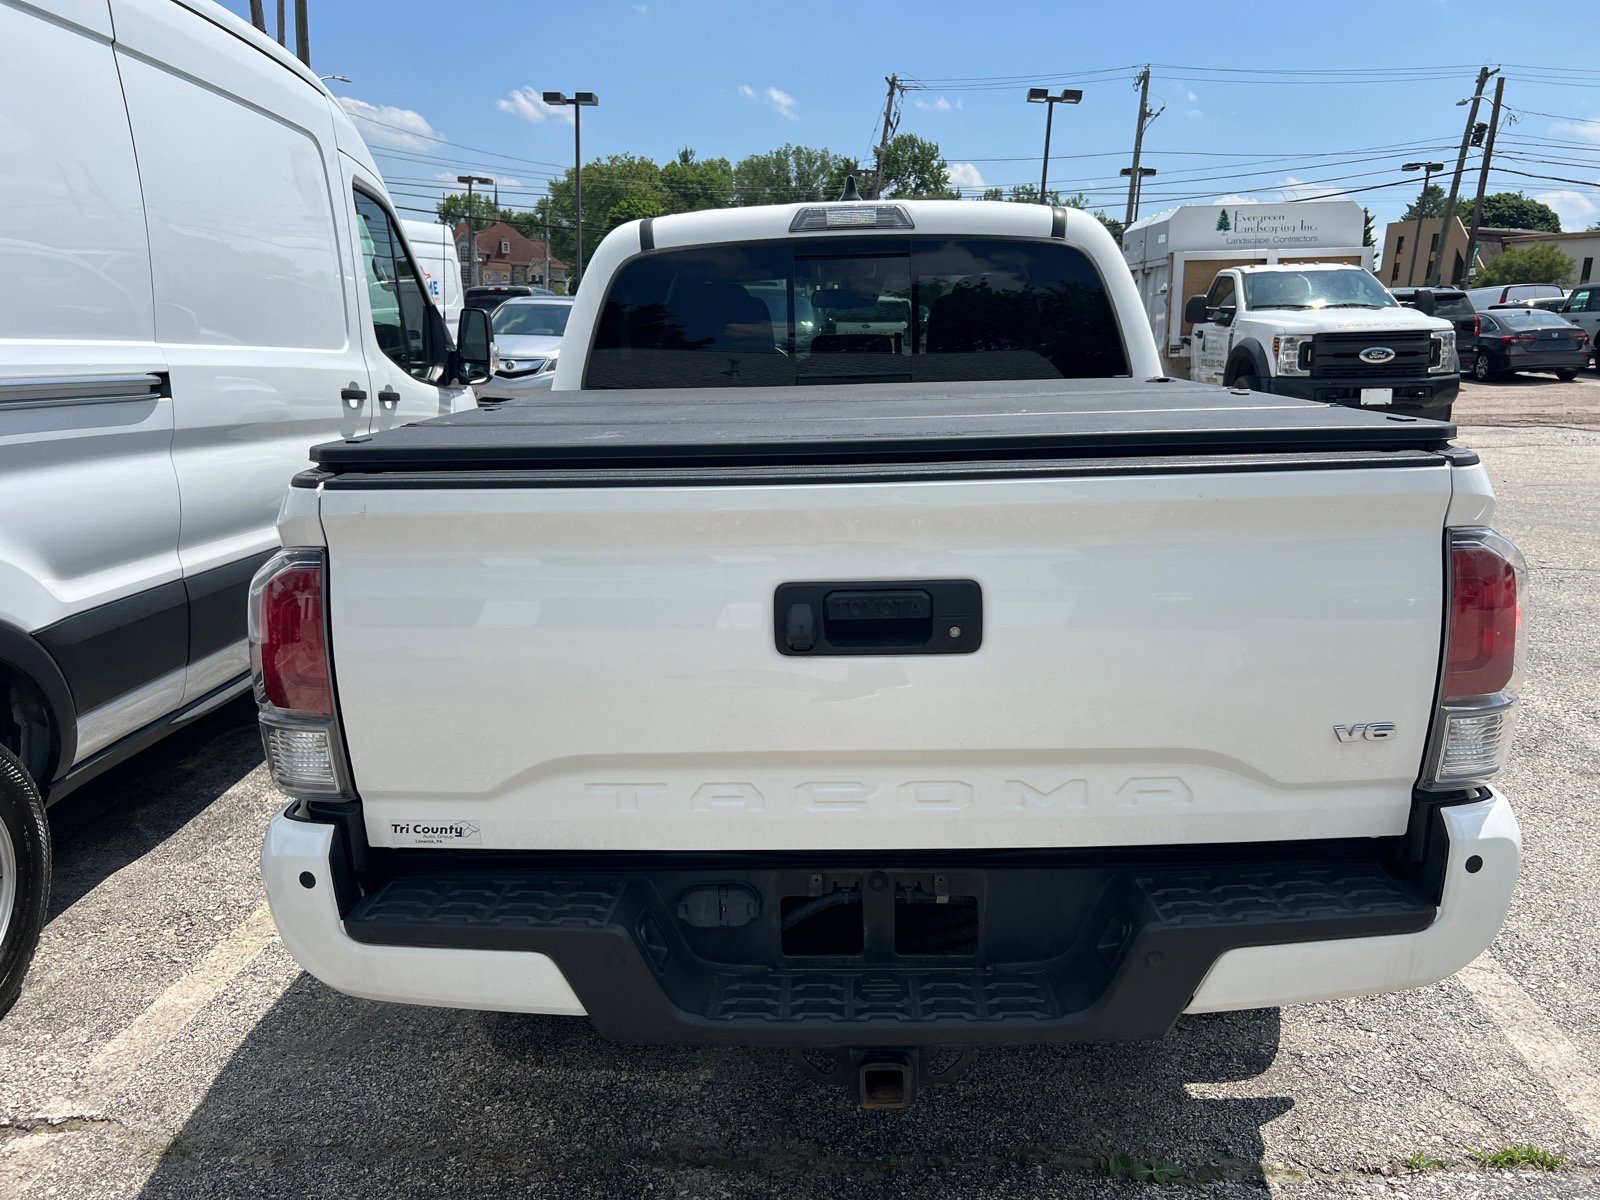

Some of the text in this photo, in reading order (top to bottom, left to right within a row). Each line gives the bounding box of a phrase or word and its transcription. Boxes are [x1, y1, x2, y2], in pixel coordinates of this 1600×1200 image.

[1234, 209, 1285, 223] Evergreen
[1234, 219, 1318, 234] Landscaping Inc.
[1226, 235, 1318, 245] Landscape Contractors
[832, 598, 921, 617] TOYOTA
[1333, 722, 1396, 743] V6
[585, 776, 1194, 814] TACOMA
[391, 823, 463, 838] Tri County
